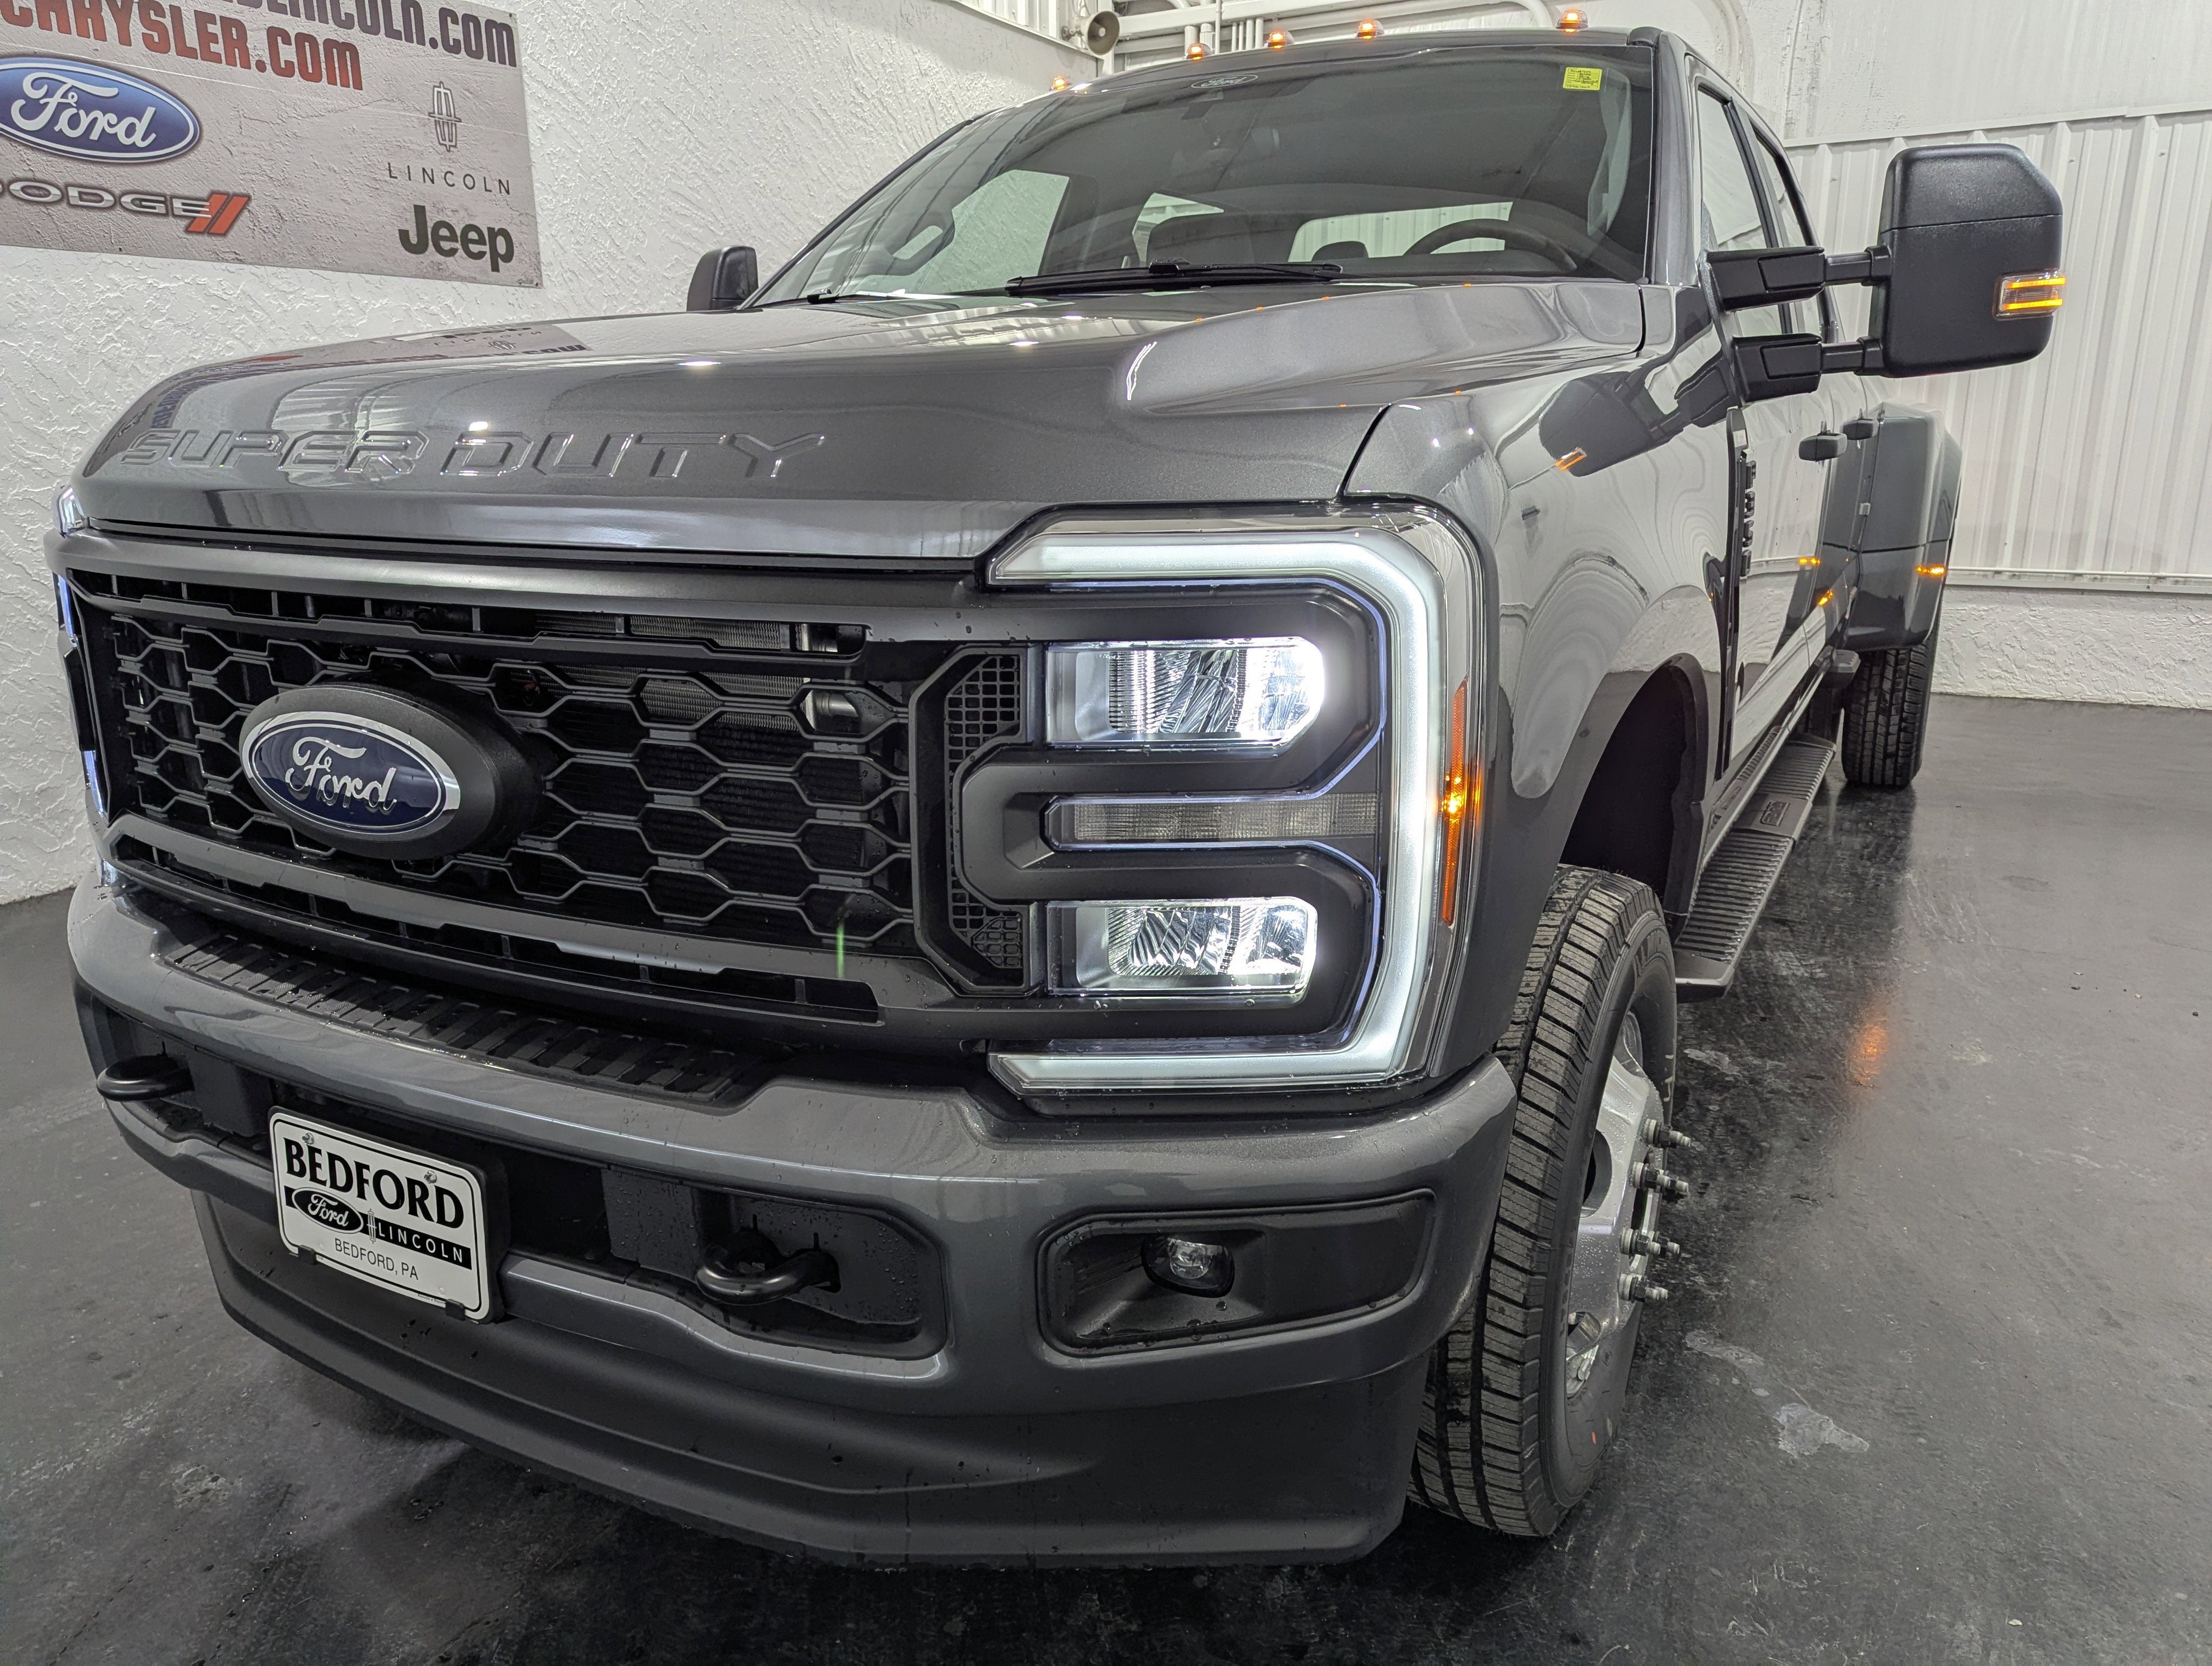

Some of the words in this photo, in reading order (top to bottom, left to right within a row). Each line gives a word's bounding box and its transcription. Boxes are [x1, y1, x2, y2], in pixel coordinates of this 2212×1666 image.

[221, 0, 517, 67] COLN.COM
[11, 72, 156, 148] Ford
[1200, 76, 1247, 87] Ford
[0, 181, 212, 217] ODGE
[388, 162, 510, 195] LINCOLN
[398, 204, 515, 273] Jeep
[120, 429, 429, 475] SUPER
[439, 432, 824, 477] DUTY
[285, 736, 397, 815] Ford
[284, 1137, 464, 1228] BEDFORD
[307, 1194, 349, 1227] Ford
[378, 1221, 462, 1263] LINCOLN
[335, 1238, 398, 1275] BEDFORD,
[401, 1262, 419, 1280] PA
